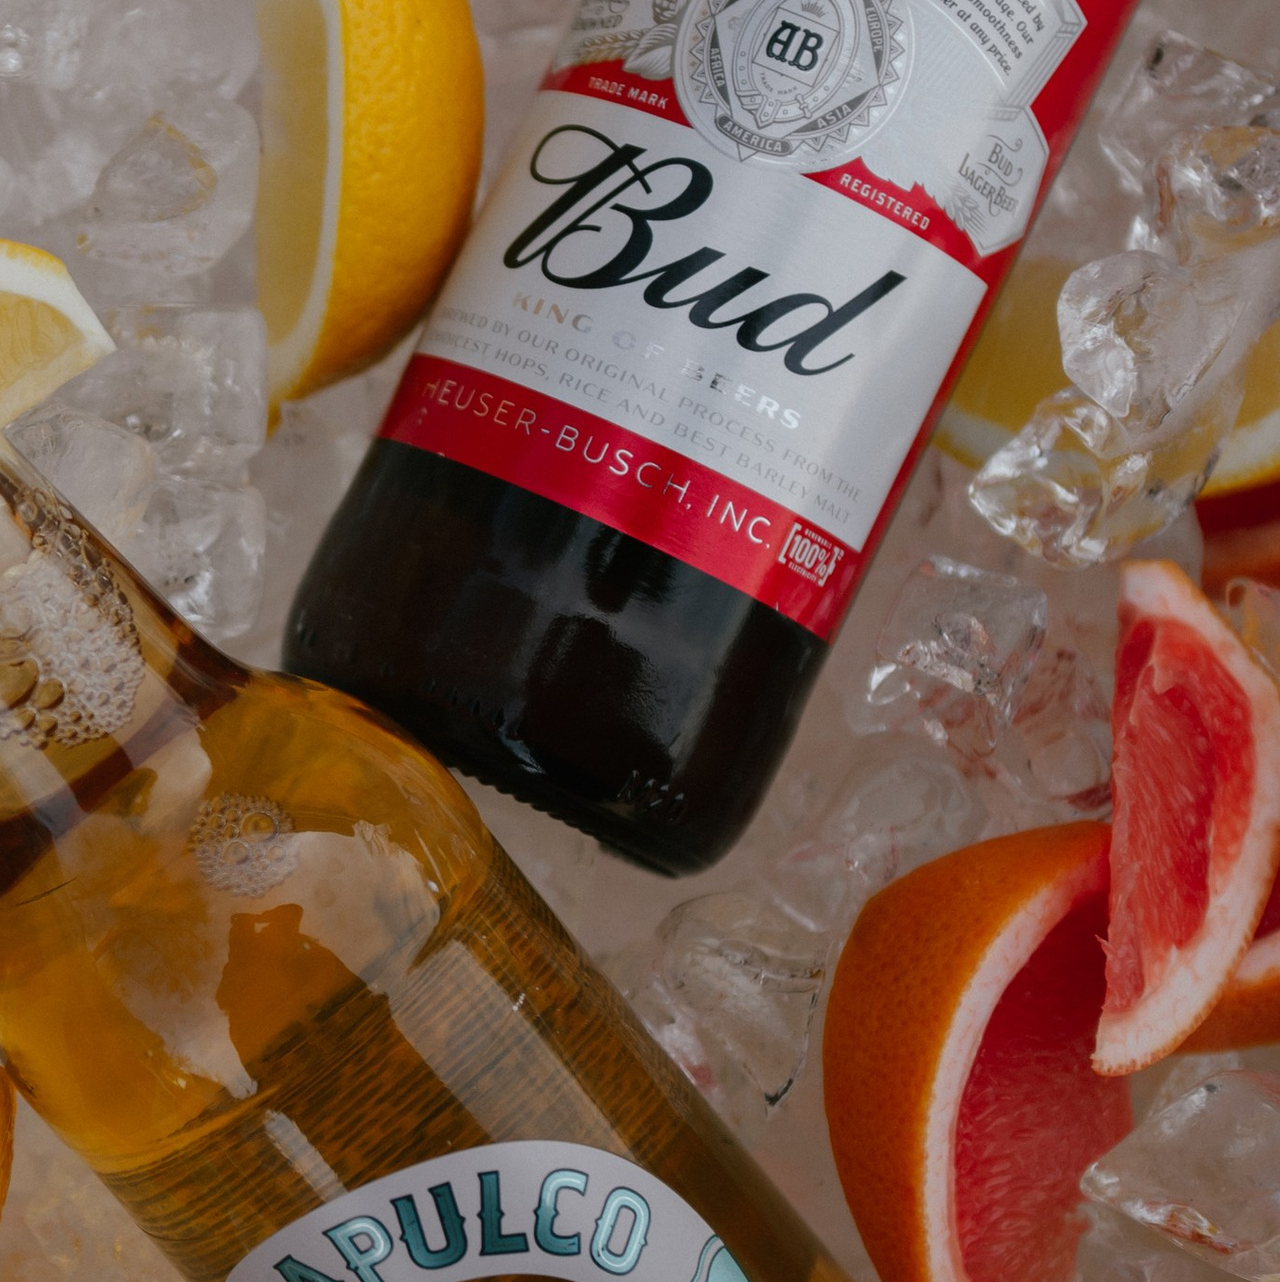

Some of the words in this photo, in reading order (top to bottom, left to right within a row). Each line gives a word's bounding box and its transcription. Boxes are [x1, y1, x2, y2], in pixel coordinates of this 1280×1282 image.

[866, 7, 884, 53] EUROPE
[957, 8, 972, 23] at
[970, 21, 991, 45] any
[987, 43, 1012, 77] price.
[1016, 20, 1035, 46] Our
[1032, 13, 1045, 33] by
[709, 47, 727, 87] AFRICA
[588, 76, 626, 97] TRADE
[626, 86, 669, 110] MARK
[816, 103, 852, 129] ASIA
[723, 120, 783, 153] AMERICA
[839, 172, 931, 231] REGISTERED
[503, 124, 907, 377] Bud
[512, 291, 595, 335] KING
[612, 329, 666, 360] OF
[680, 358, 803, 430] BEERS
[491, 320, 511, 337] BY
[517, 329, 560, 355] OUR
[565, 347, 674, 403] ORIGINAL
[678, 396, 777, 455] PROCESS
[783, 448, 835, 485] FROM
[833, 477, 862, 503] THE
[495, 349, 551, 381] HOPS,
[558, 372, 613, 404] RICE
[616, 397, 666, 428] AND
[673, 421, 730, 458] BEST
[735, 452, 810, 500] BARLEY
[813, 493, 851, 527] MALT
[706, 494, 772, 549] INC.
[788, 534, 832, 577] 100%
